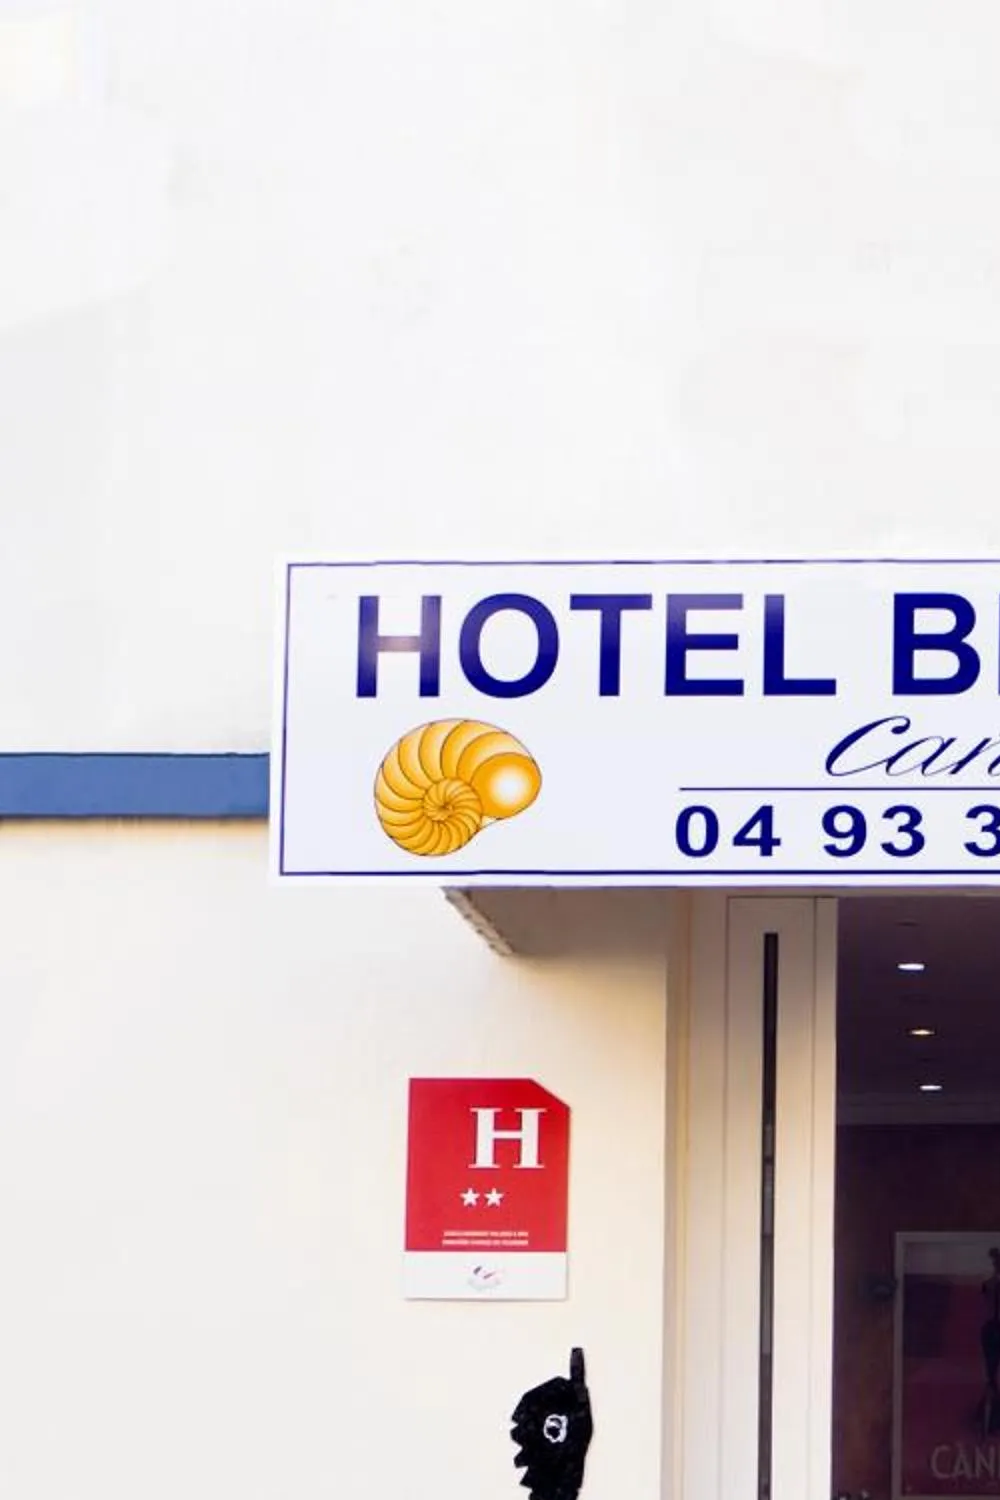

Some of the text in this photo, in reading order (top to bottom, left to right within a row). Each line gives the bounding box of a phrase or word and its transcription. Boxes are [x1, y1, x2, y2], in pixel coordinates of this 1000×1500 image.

[356, 593, 837, 699] HOTEL
[675, 804, 781, 858] 04
[821, 803, 926, 858] 93
[468, 1107, 547, 1169] H
